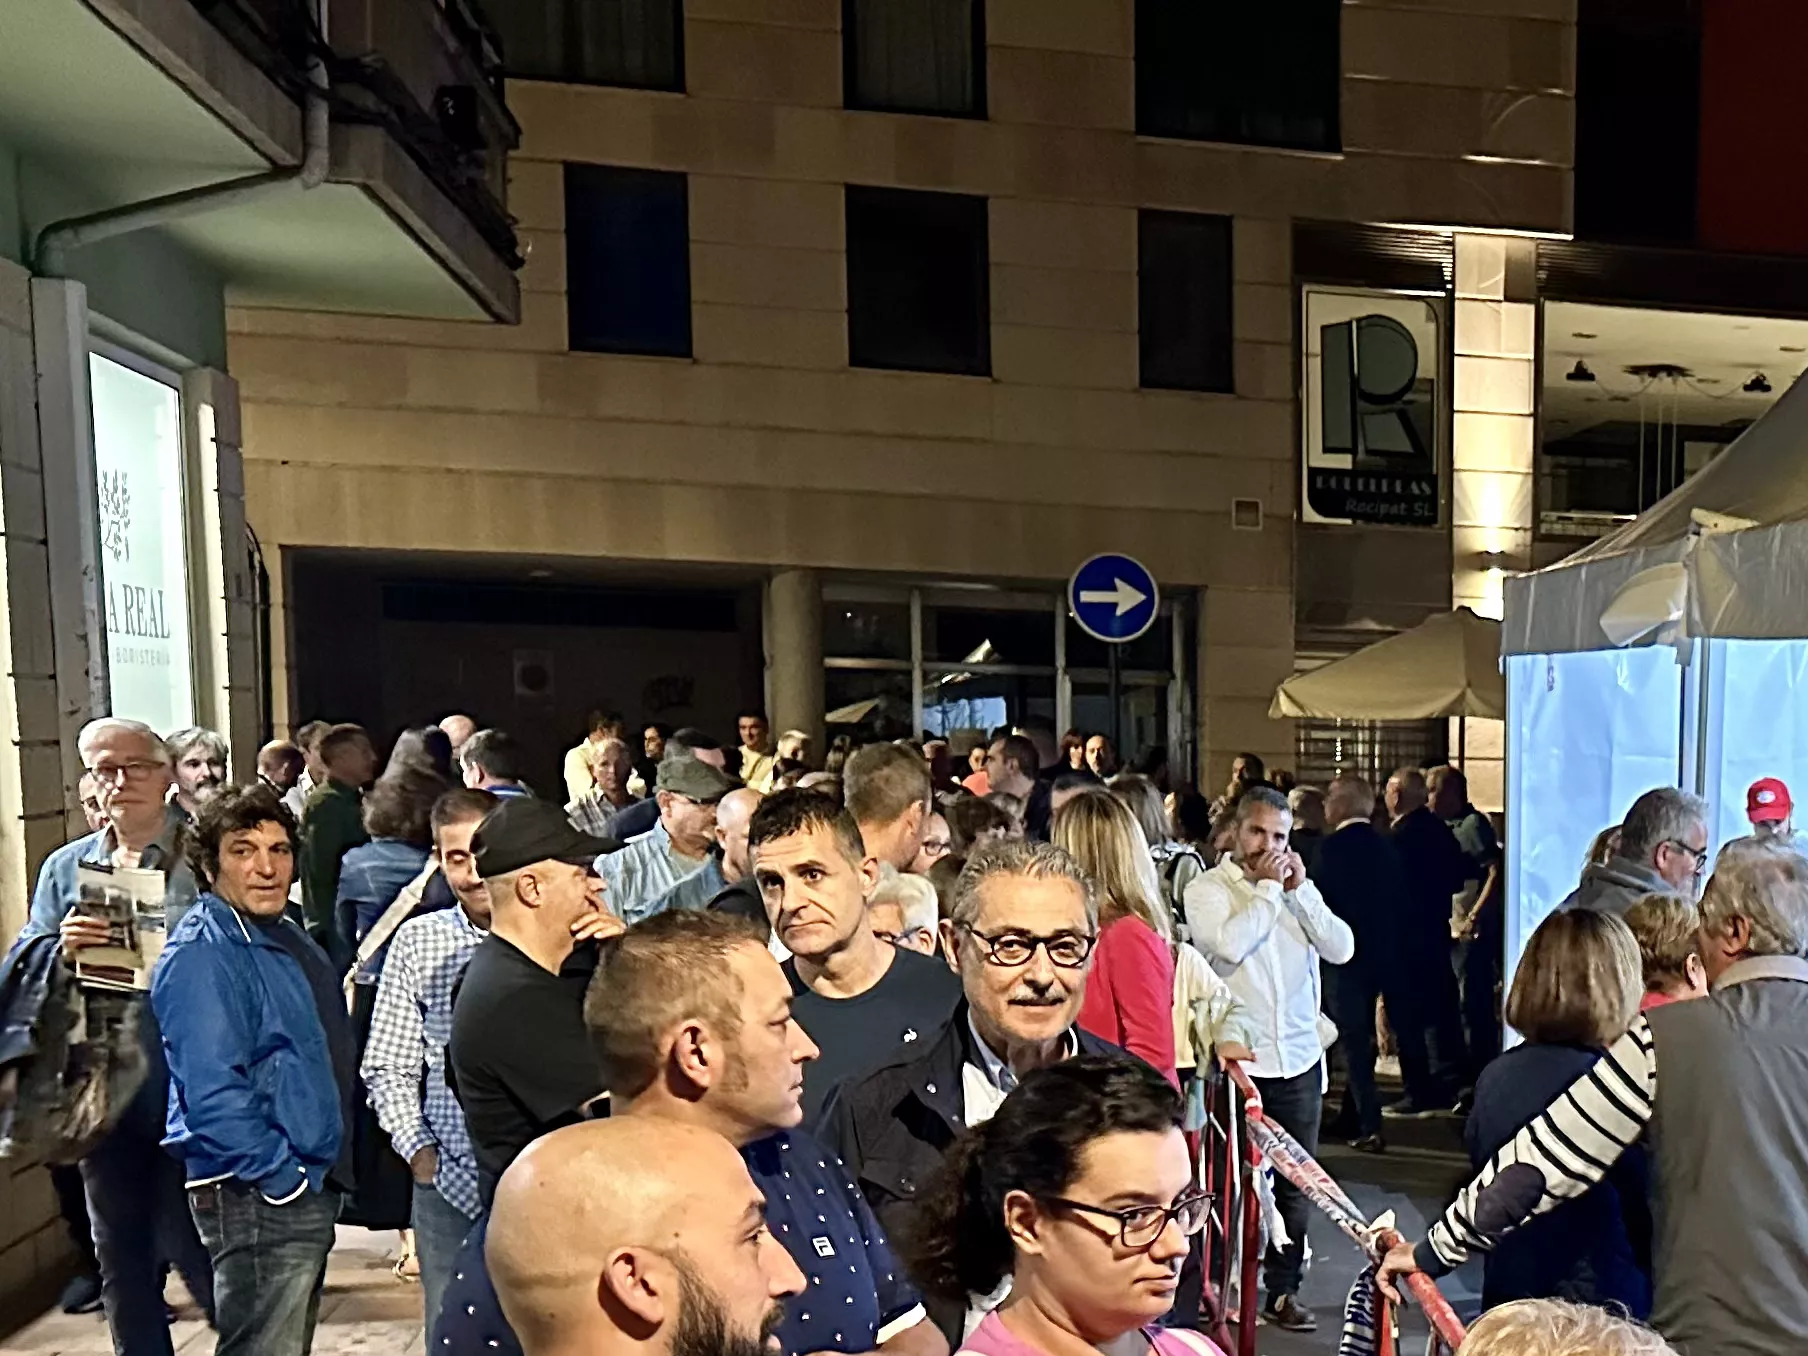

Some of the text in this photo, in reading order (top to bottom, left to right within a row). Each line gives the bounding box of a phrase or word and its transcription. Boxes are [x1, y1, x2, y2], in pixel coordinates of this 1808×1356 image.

[1413, 502, 1435, 517] SL
[109, 581, 170, 638] A REAL
